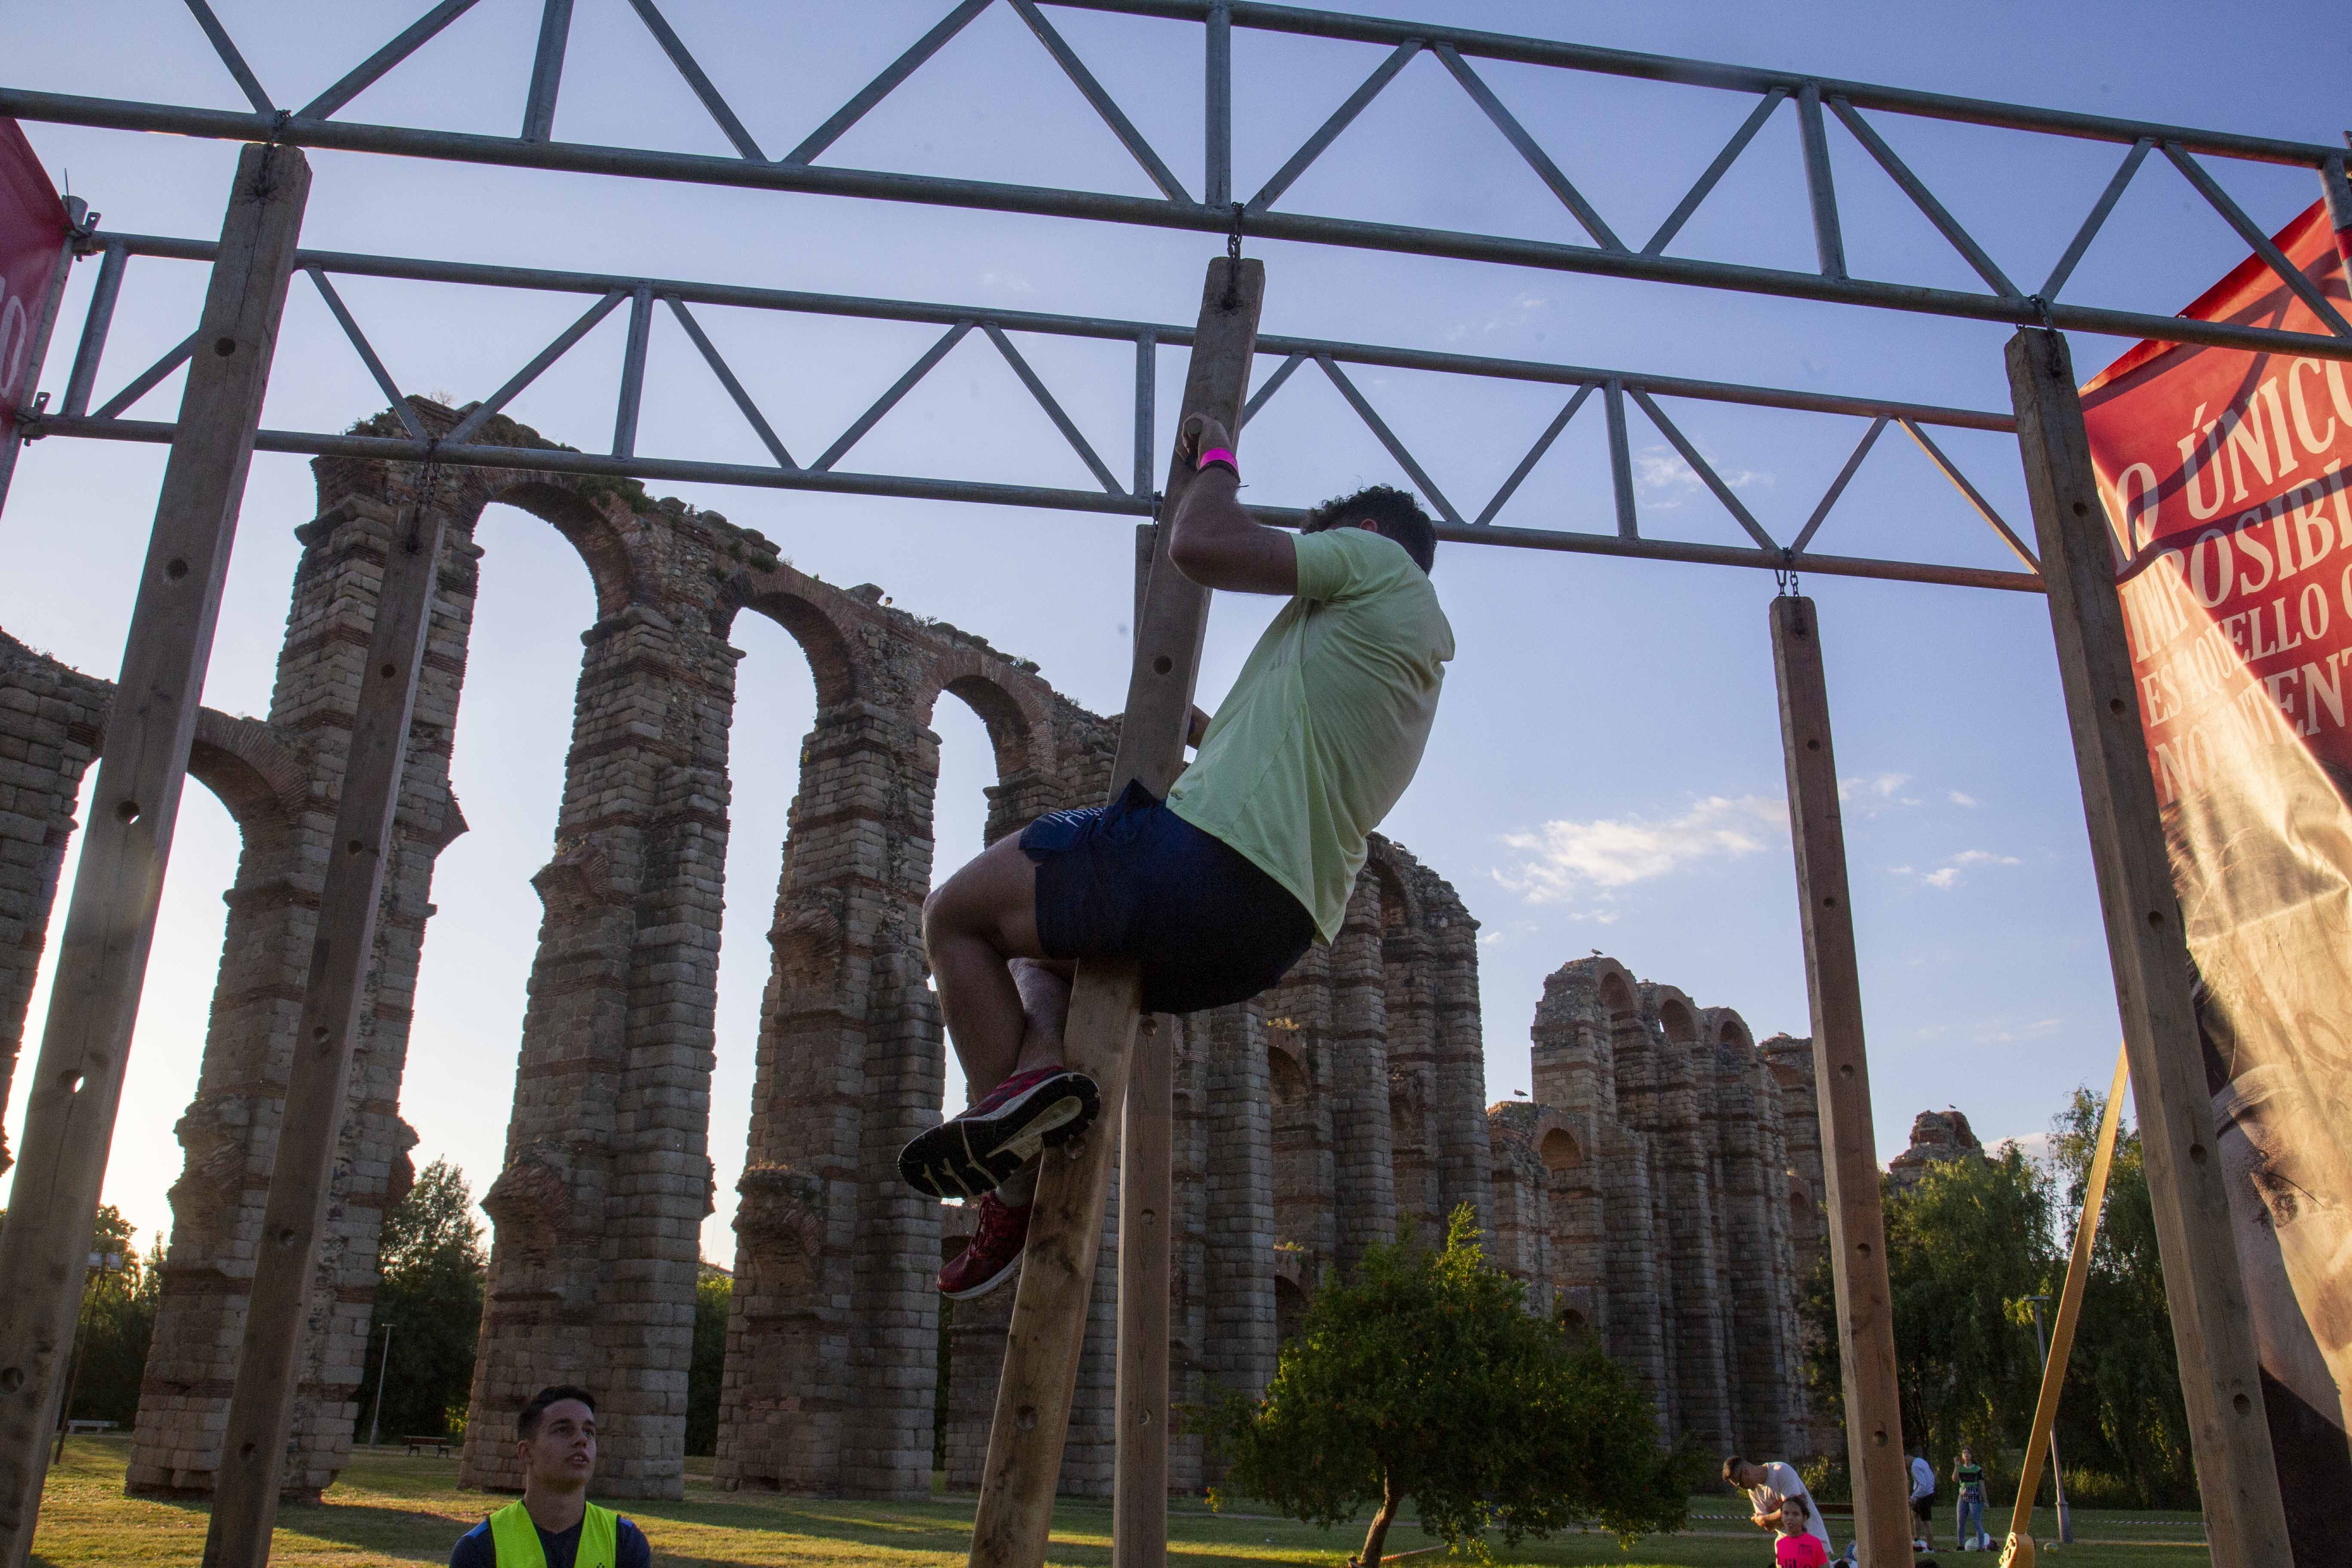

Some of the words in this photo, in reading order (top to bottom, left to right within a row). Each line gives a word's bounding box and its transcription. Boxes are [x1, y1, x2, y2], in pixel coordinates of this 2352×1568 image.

[2141, 663, 2183, 727] ES
[2185, 583, 2329, 704] AQUELLO
[2155, 725, 2217, 804] NO
